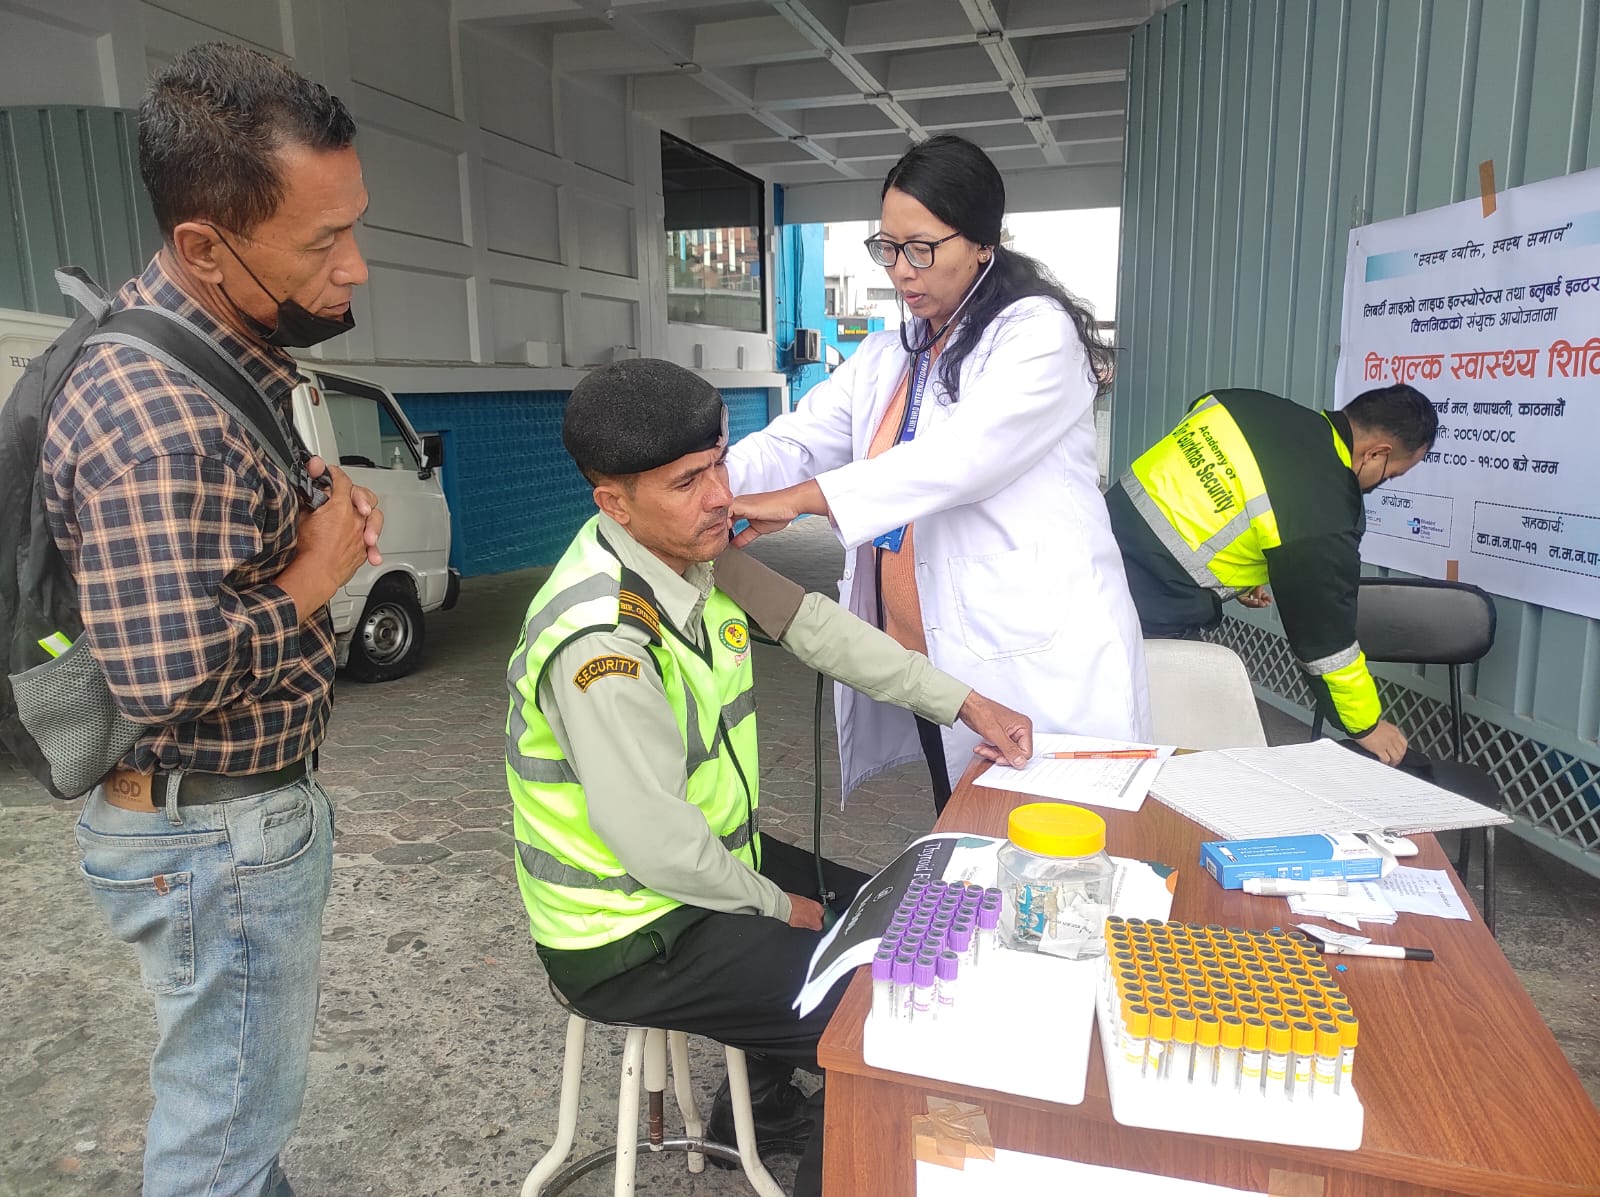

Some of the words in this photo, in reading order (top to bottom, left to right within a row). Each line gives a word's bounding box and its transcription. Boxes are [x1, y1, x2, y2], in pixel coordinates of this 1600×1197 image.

[1492, 235, 1523, 255] स्वस्थ
[1363, 299, 1388, 318] लिबर्टी
[1388, 296, 1416, 316] माइक्रो
[1418, 296, 1445, 313] लाइफ
[1505, 286, 1526, 302] तथा
[1529, 274, 1563, 303] ब्लुबर्ड
[1410, 312, 1464, 333] क्लिनिकको
[1466, 312, 1497, 332] संयुक्त
[1498, 305, 1559, 326] आयोजनामा
[1450, 348, 1540, 379] स्वास्थ्य
[1473, 399, 1513, 417] थापाथली,
[1199, 425, 1228, 466] Academy
[1453, 428, 1516, 443] २०८१/०८/०८
[1177, 431, 1206, 469] Gurkhas
[1196, 462, 1235, 514] Security
[1423, 451, 1441, 464] हान
[1443, 452, 1467, 466] ८:००
[1478, 455, 1510, 470] ११:००
[1512, 454, 1529, 472] बजे
[1531, 459, 1559, 475] सम्म
[1521, 515, 1565, 534] सहकार्य:
[577, 658, 637, 686] SECURITY
[916, 841, 942, 873] Thyroid
